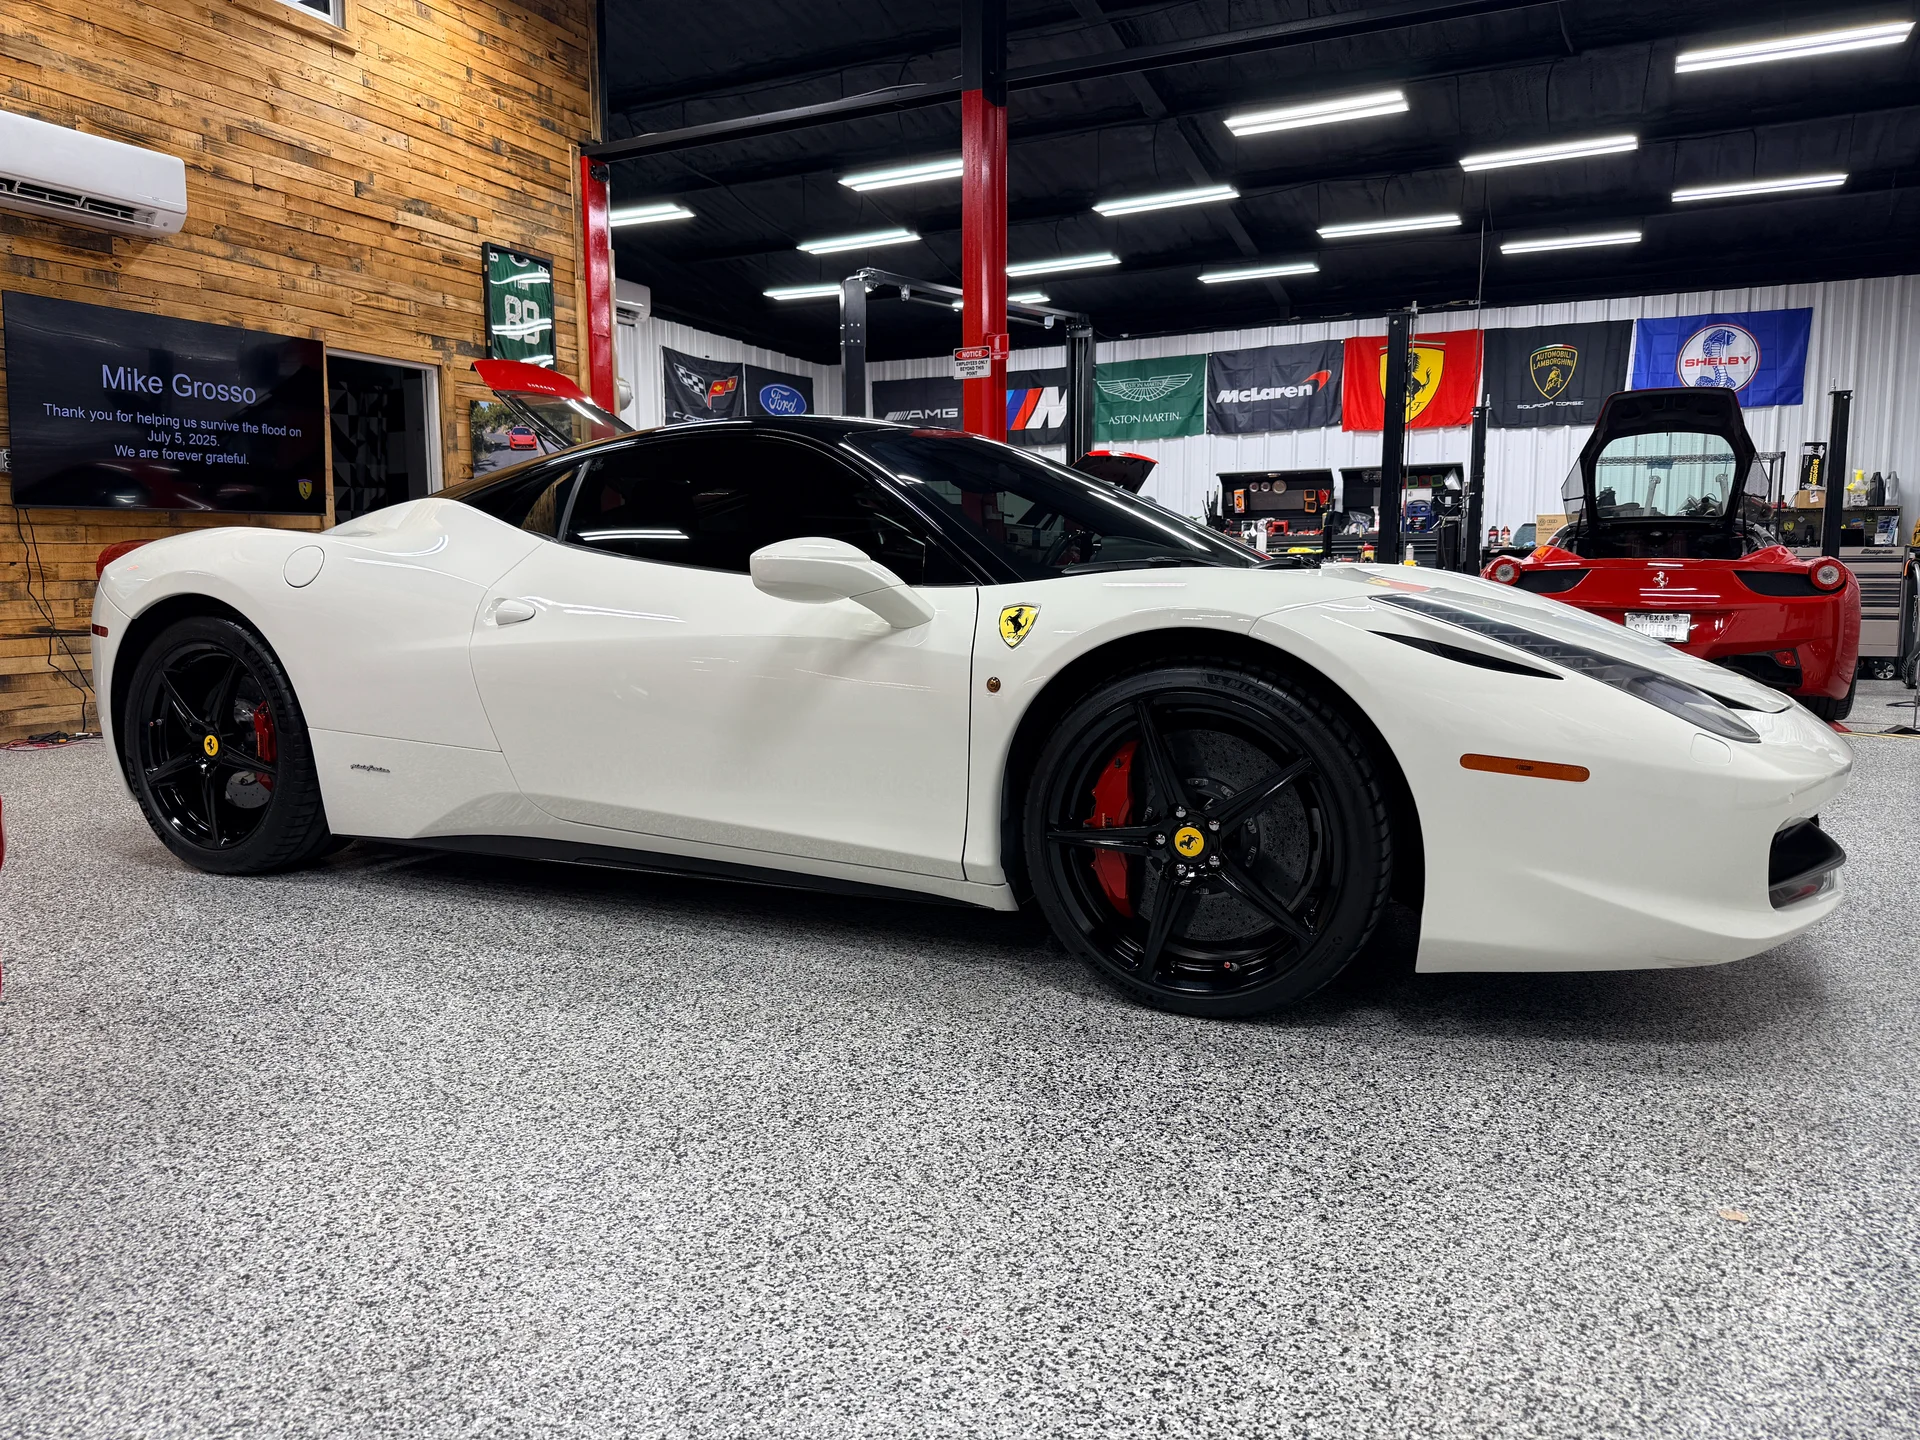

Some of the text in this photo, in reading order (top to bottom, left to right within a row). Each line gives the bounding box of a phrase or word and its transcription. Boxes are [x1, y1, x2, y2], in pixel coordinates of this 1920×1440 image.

[962, 350, 982, 358] NOTICE
[1536, 351, 1572, 361] AUTOMOBILI
[1684, 356, 1752, 367] SHELBY
[1533, 358, 1573, 370] LAMBORGHINI
[102, 364, 256, 405] Mike Grosso
[769, 388, 797, 413] Ford
[1216, 384, 1313, 404] McLaren
[43, 403, 302, 437] Thank you for helping us survive the flood on
[907, 408, 958, 420] AMG
[1108, 412, 1180, 425] ASTON MARTIN
[147, 430, 220, 447] July 5, 2025.
[114, 444, 249, 466] We are forever grateful.
